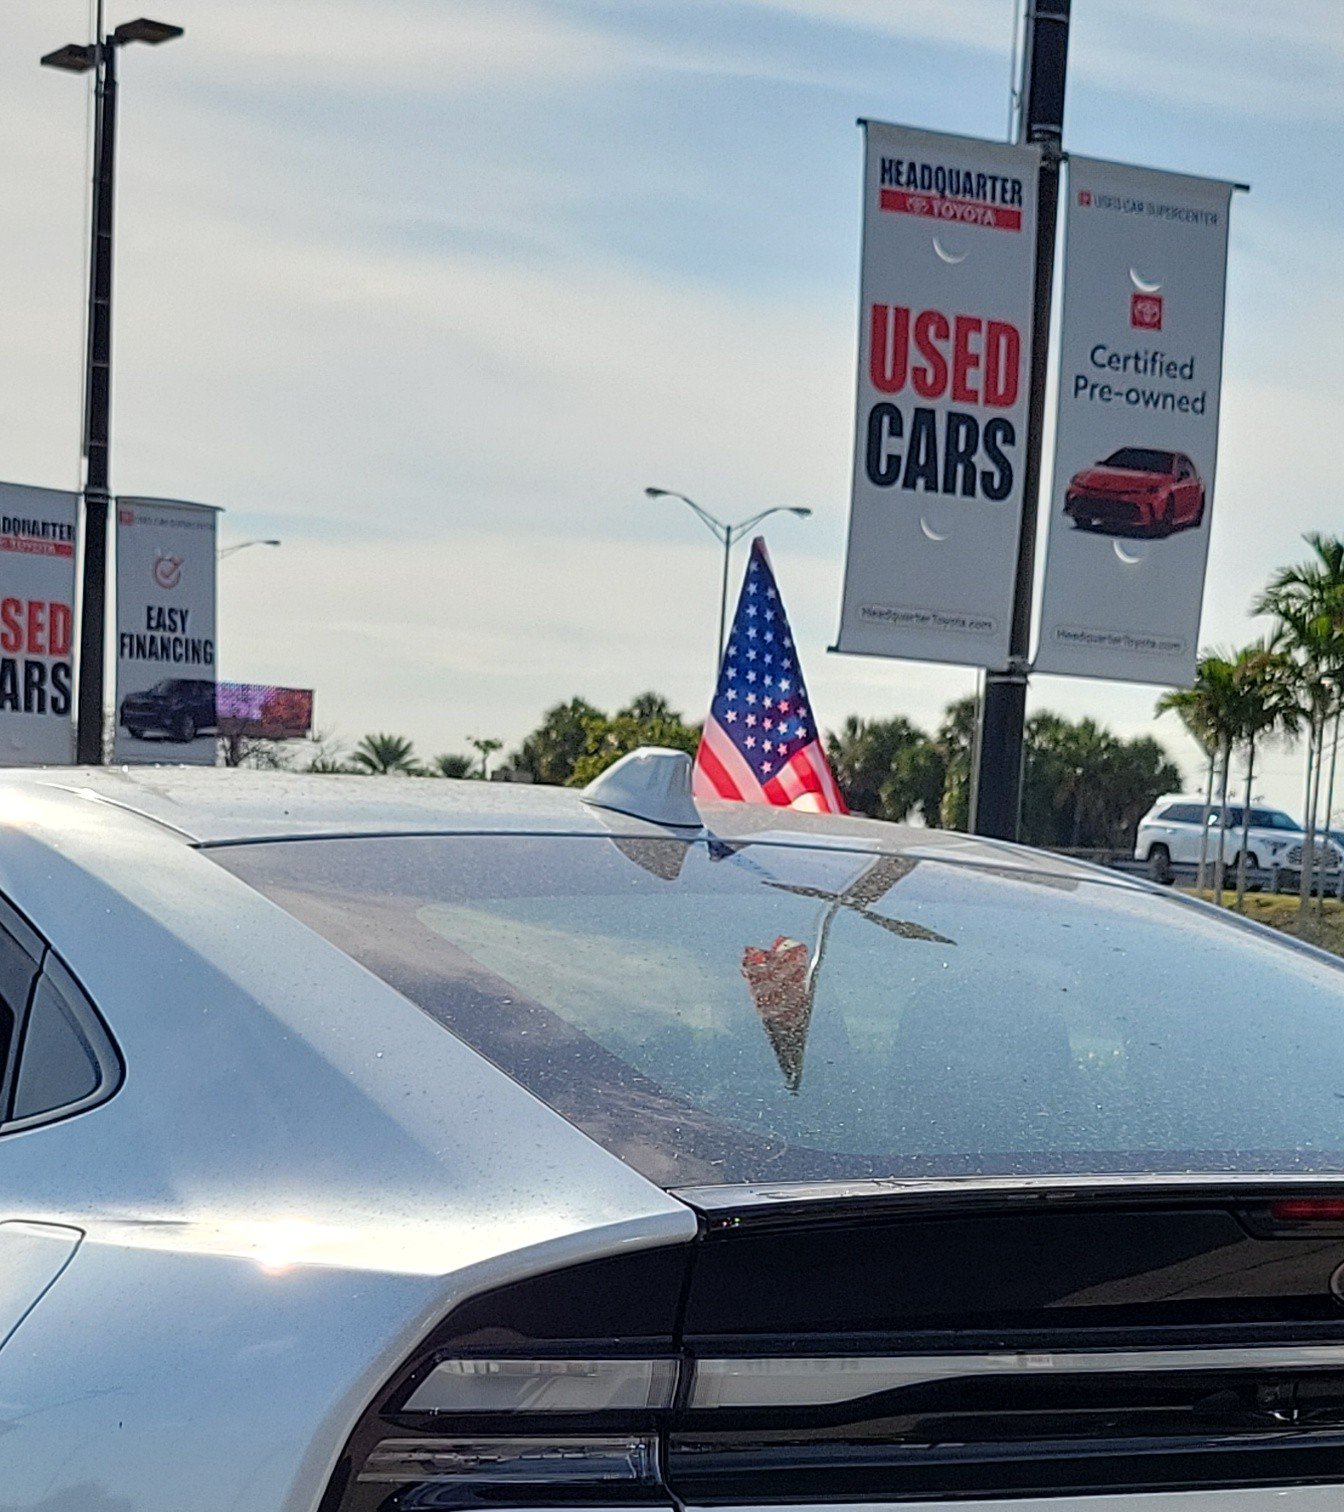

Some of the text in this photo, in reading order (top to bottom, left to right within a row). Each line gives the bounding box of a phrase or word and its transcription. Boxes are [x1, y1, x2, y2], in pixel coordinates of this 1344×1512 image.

[880, 157, 1023, 206] HEADQUARTER
[932, 200, 996, 226] TOYOTA
[868, 304, 1022, 406] USED
[1090, 344, 1195, 380] Certified
[1073, 376, 1206, 415] Pre-owned
[865, 402, 1017, 501] CARS
[146, 605, 189, 634] EASY
[119, 632, 214, 664] FINANCING
